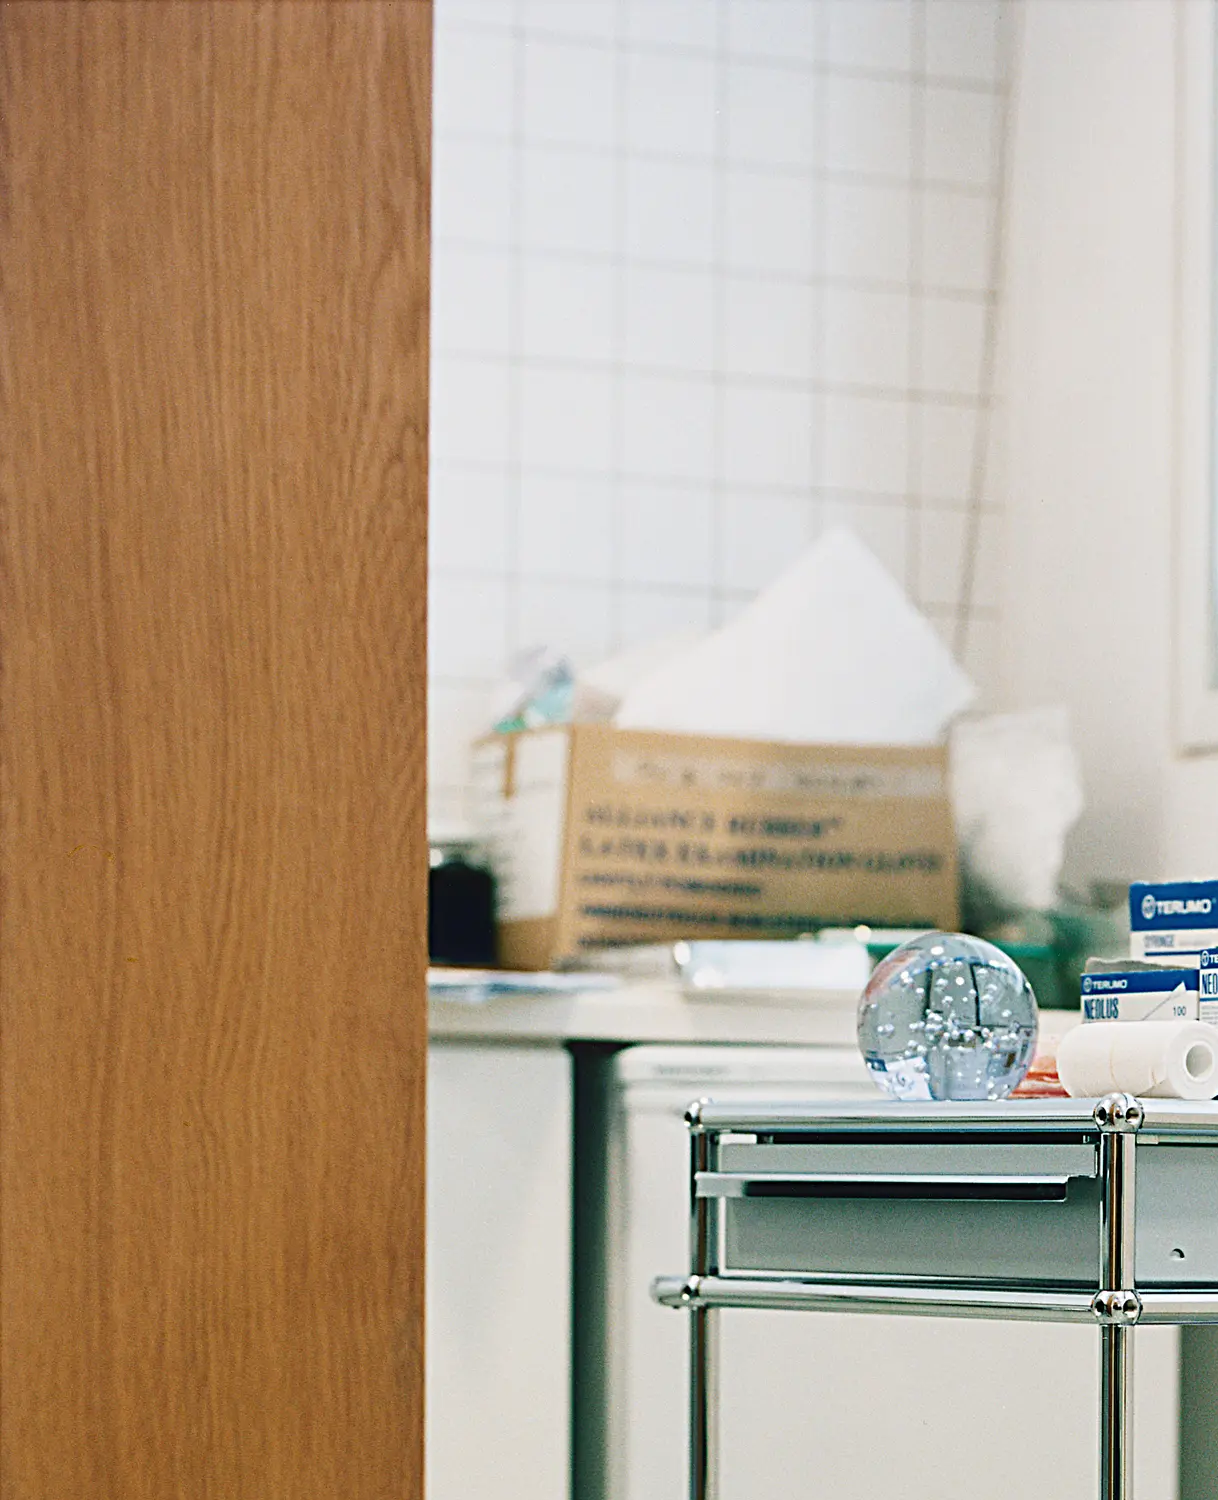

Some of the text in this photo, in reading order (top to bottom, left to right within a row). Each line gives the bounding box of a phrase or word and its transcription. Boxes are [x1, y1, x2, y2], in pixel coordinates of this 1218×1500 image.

[1157, 898, 1213, 916] TERUMO
[1092, 979, 1129, 990] TERUMO
[1084, 997, 1119, 1019] NEOLUS
[1173, 1005, 1187, 1017] 100
